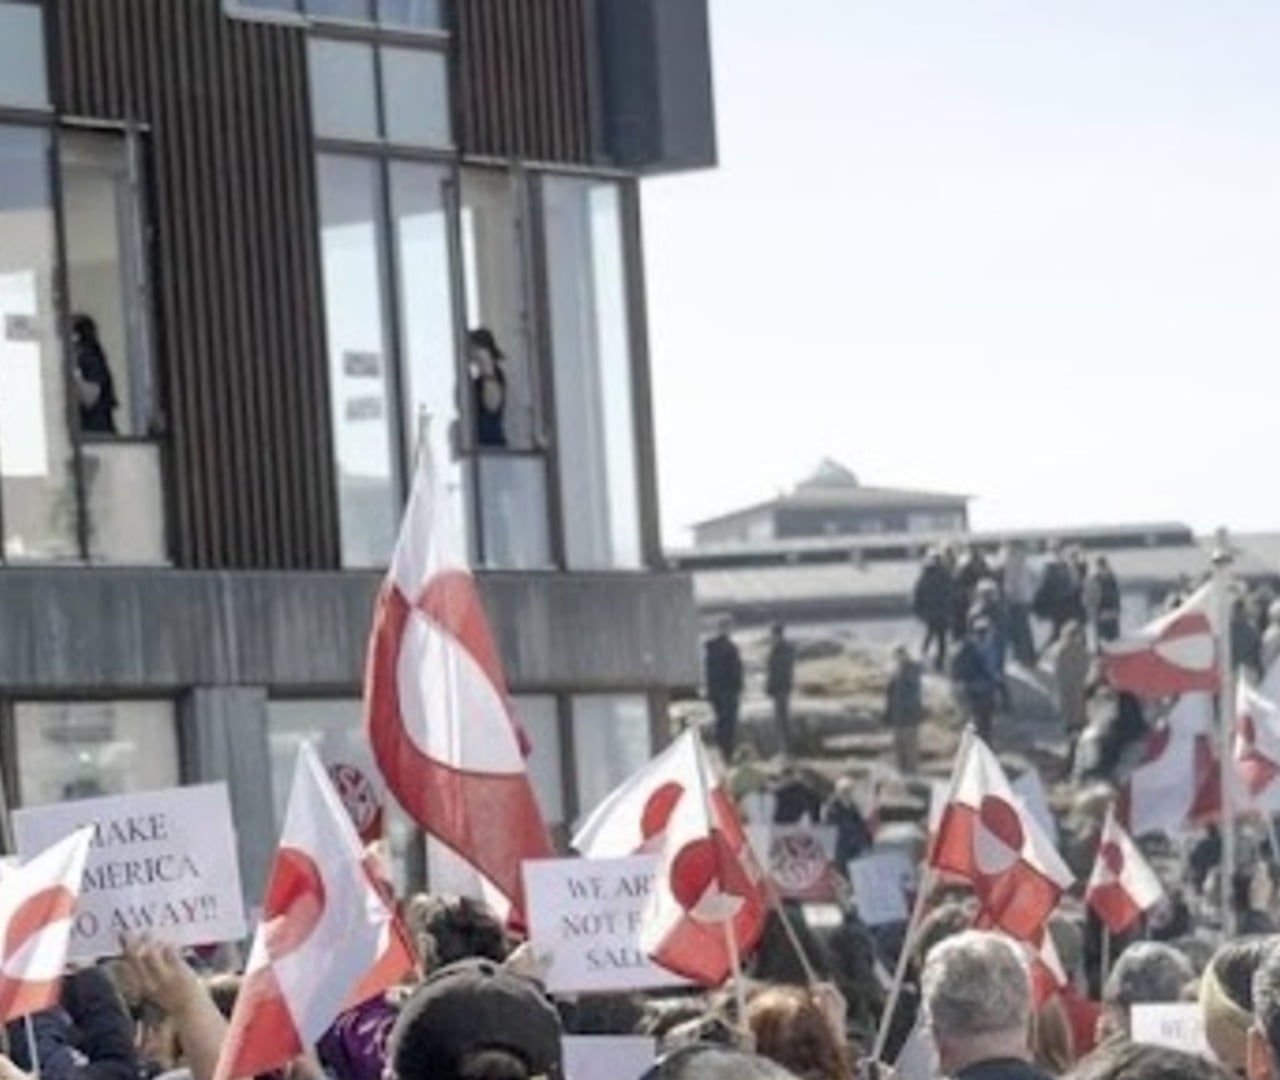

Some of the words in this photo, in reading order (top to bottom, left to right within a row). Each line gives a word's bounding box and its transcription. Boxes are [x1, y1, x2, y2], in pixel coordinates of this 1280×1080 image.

[82, 854, 200, 894] MERICA
[567, 876, 606, 900] WE
[615, 873, 655, 897] AR
[112, 896, 218, 931] AWAY!!
[563, 913, 616, 938] NOT
